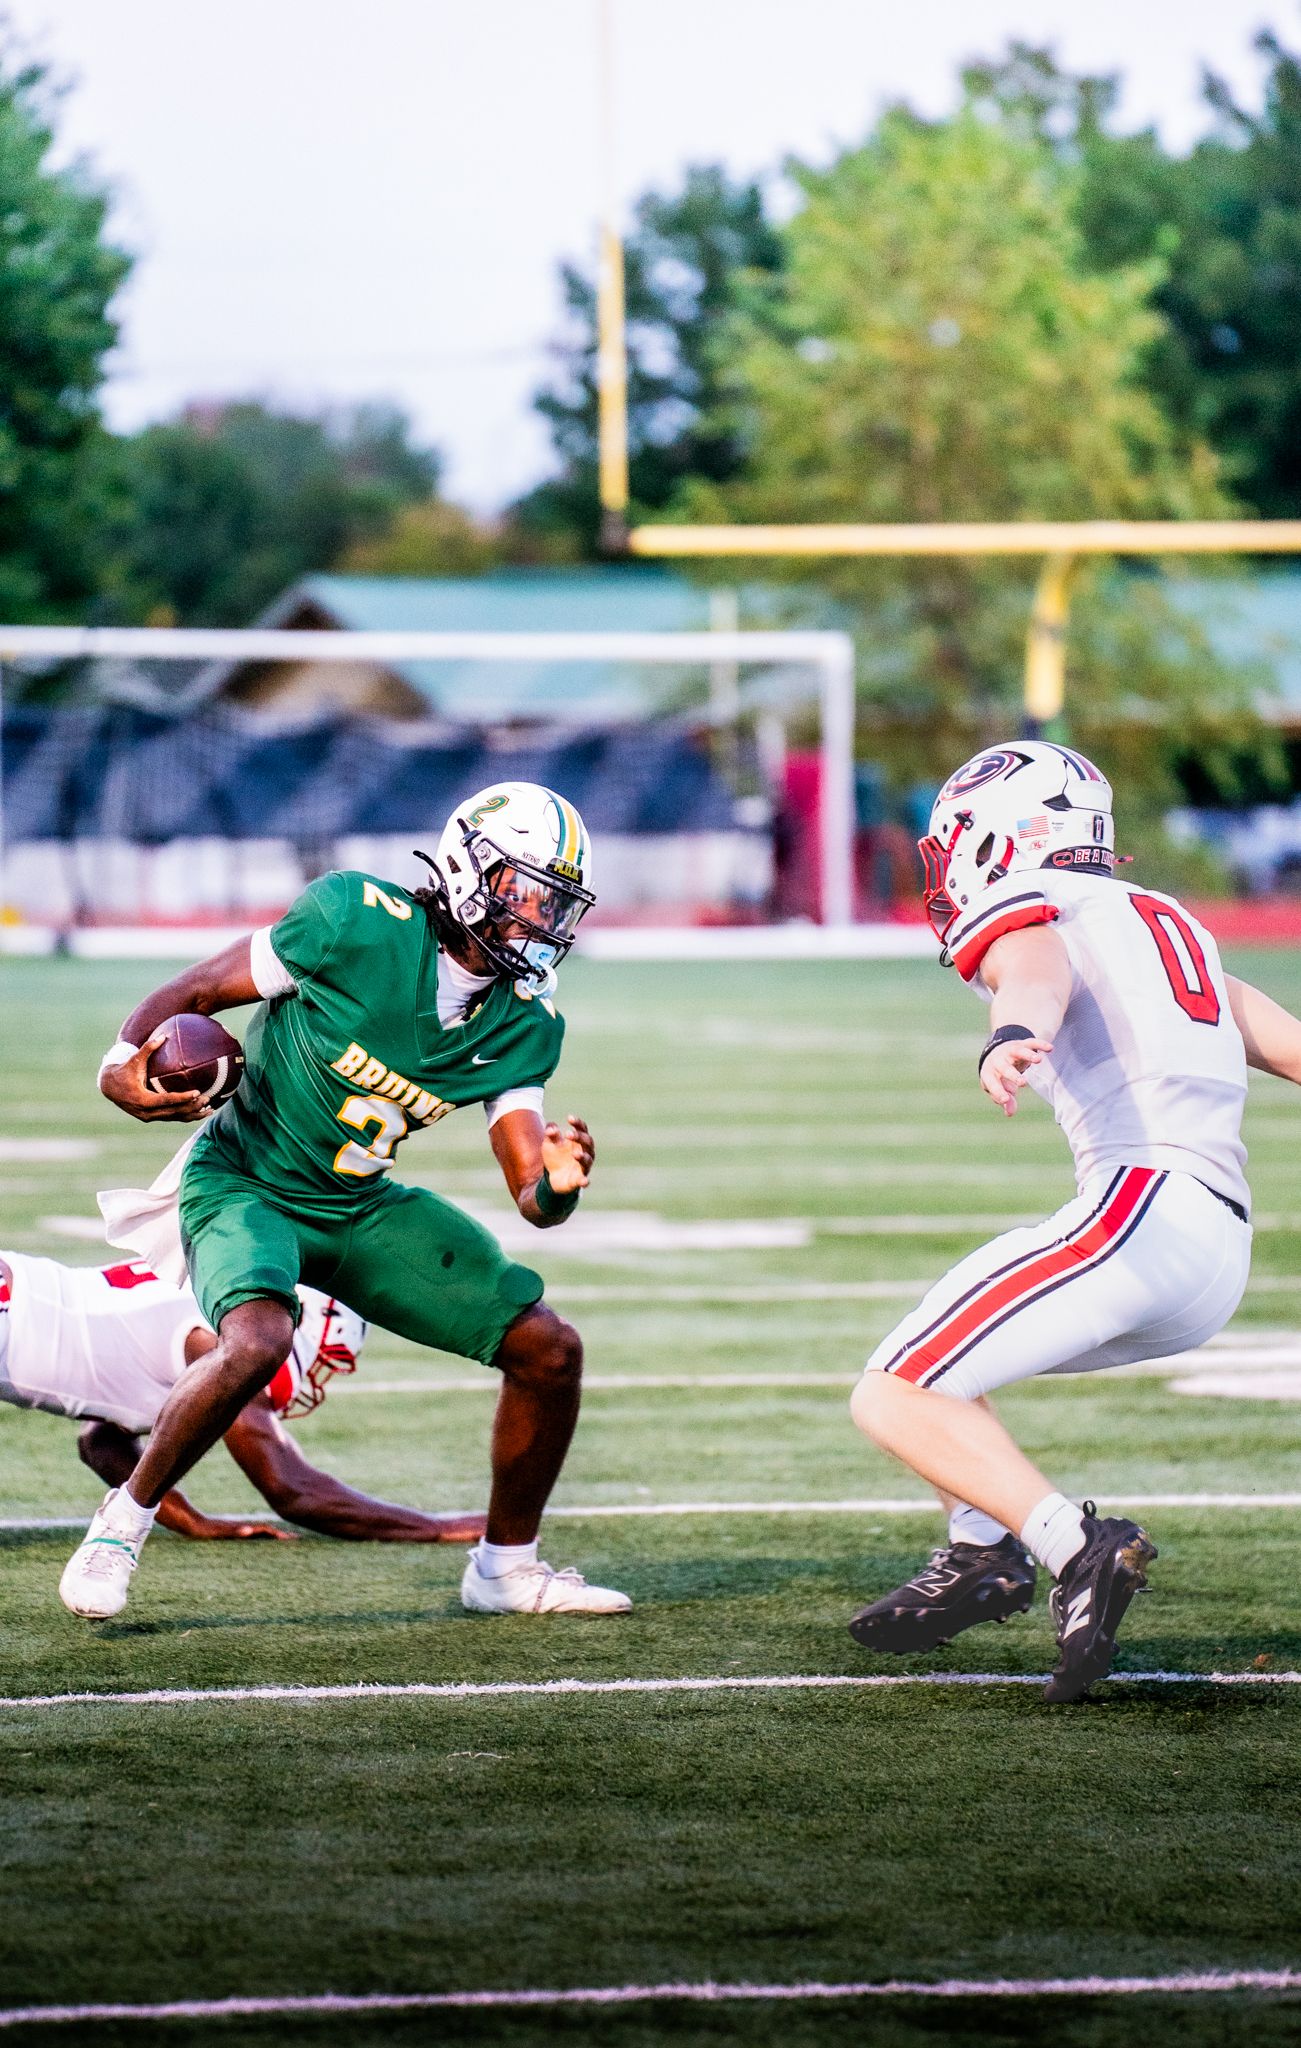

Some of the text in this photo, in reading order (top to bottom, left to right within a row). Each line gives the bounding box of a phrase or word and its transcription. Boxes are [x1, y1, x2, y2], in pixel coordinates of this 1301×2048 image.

[466, 795, 509, 828] 2
[1073, 848, 1091, 863] BE
[1091, 848, 1100, 863] A
[363, 880, 412, 920] 2
[1127, 892, 1220, 1027] 0
[330, 1042, 457, 1125] BRUINS
